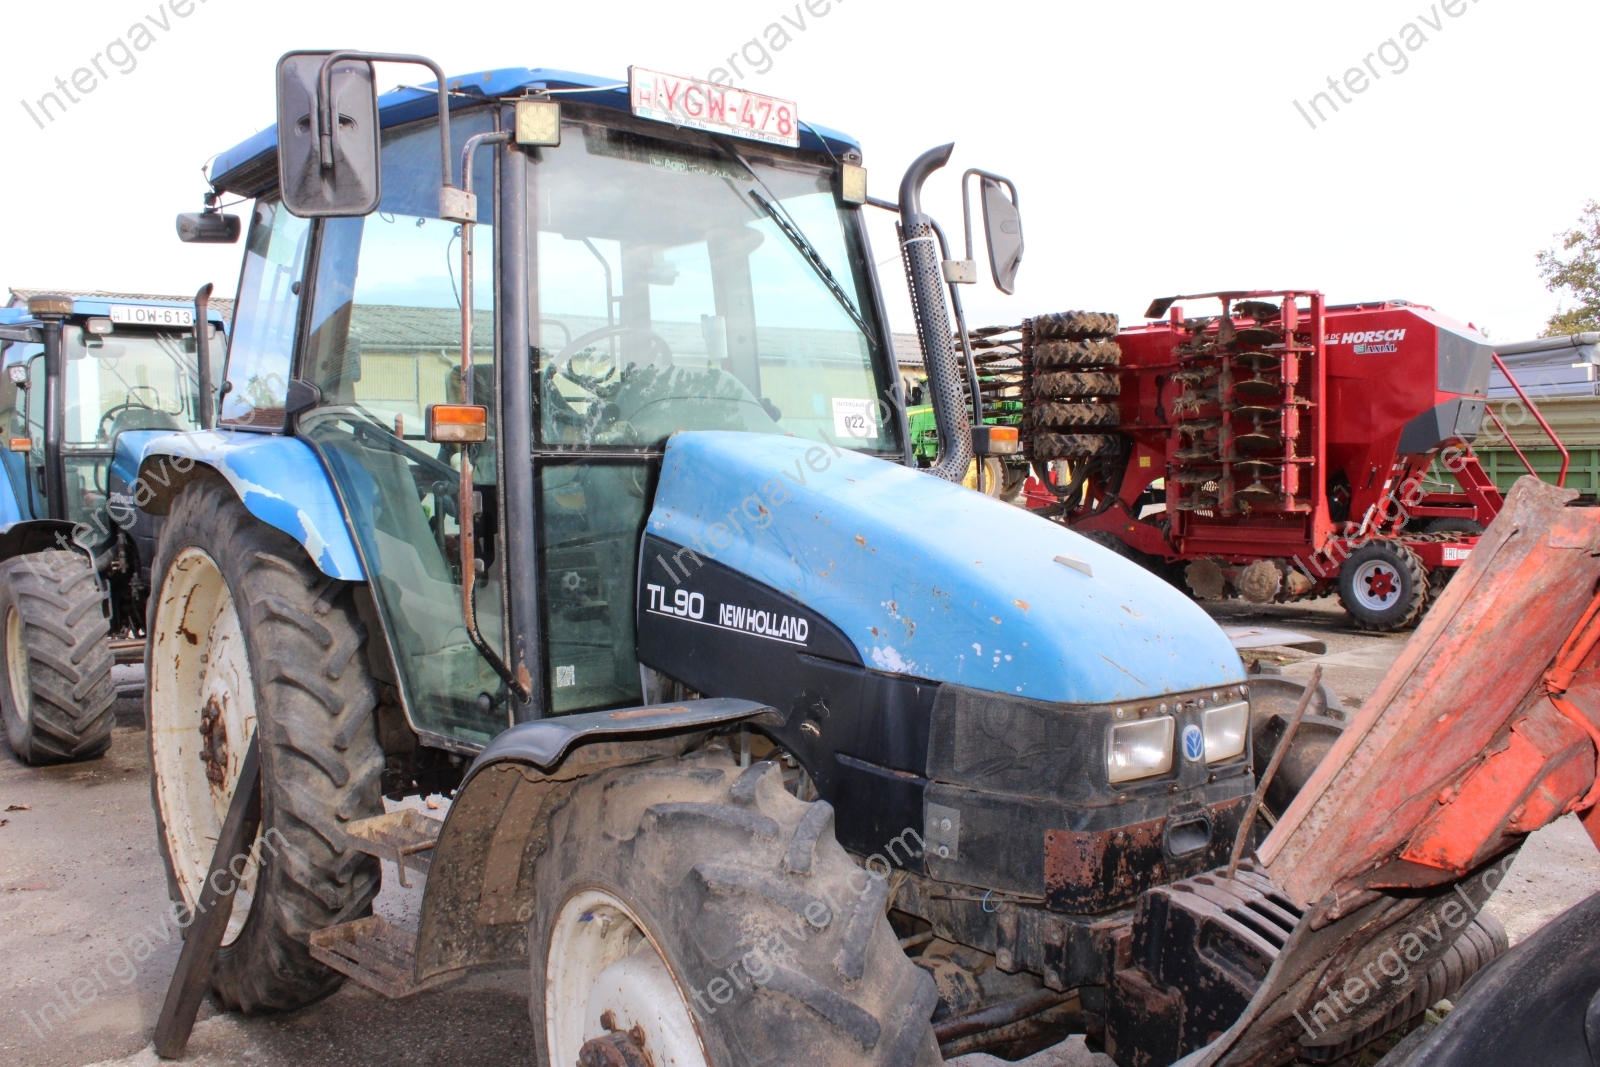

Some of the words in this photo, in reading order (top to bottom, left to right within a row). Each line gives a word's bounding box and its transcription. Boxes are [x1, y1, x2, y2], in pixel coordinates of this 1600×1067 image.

[662, 78, 791, 136] YGW-478
[664, 158, 686, 172] Agip
[127, 308, 191, 324] IOW-613
[1330, 332, 1341, 340] DC
[1341, 329, 1406, 344] HORSCH
[844, 415, 866, 429] 022
[1445, 548, 1456, 559] EAC
[647, 583, 705, 620] TL90
